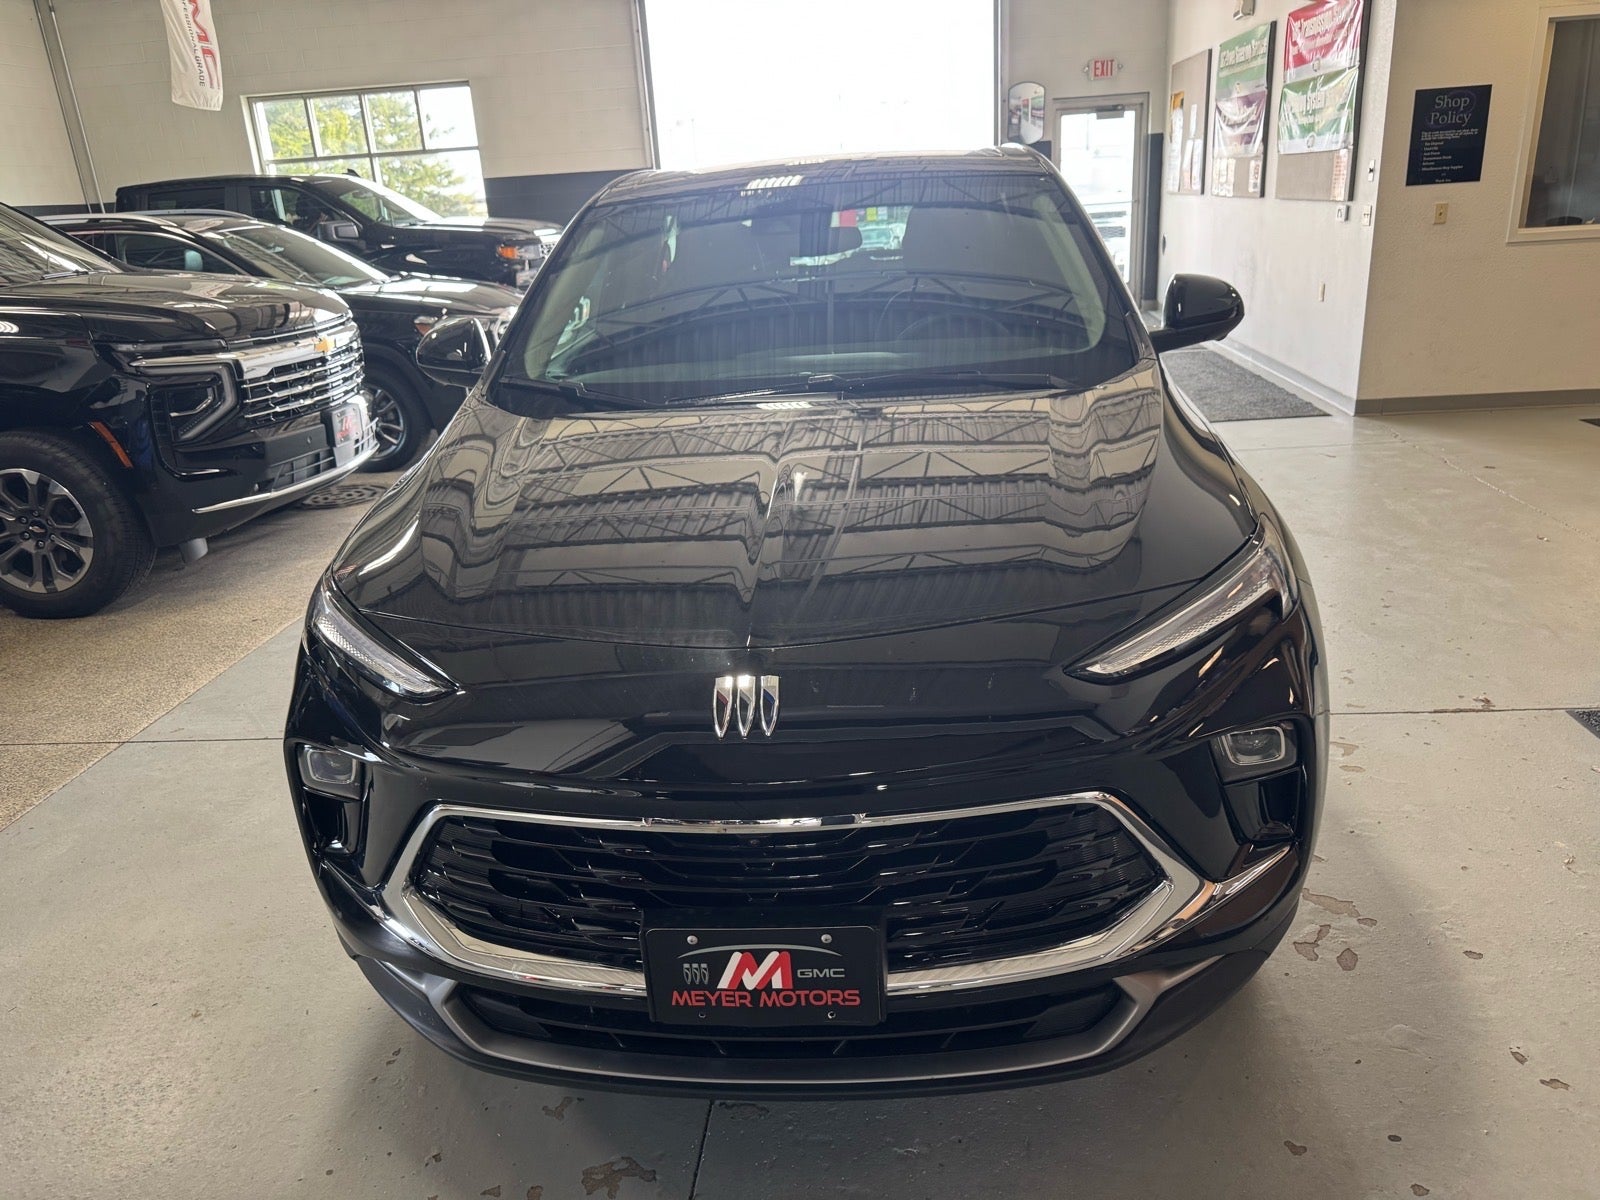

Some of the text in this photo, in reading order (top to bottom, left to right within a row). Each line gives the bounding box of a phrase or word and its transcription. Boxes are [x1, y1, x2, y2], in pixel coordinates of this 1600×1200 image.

[195, 56, 205, 87] GRADE
[1093, 59, 1115, 77] EXIT
[1434, 94, 1470, 111] Shop
[1430, 110, 1471, 127] Policy
[796, 968, 845, 978] GMC
[671, 989, 861, 1007] MEYER MOTORS
